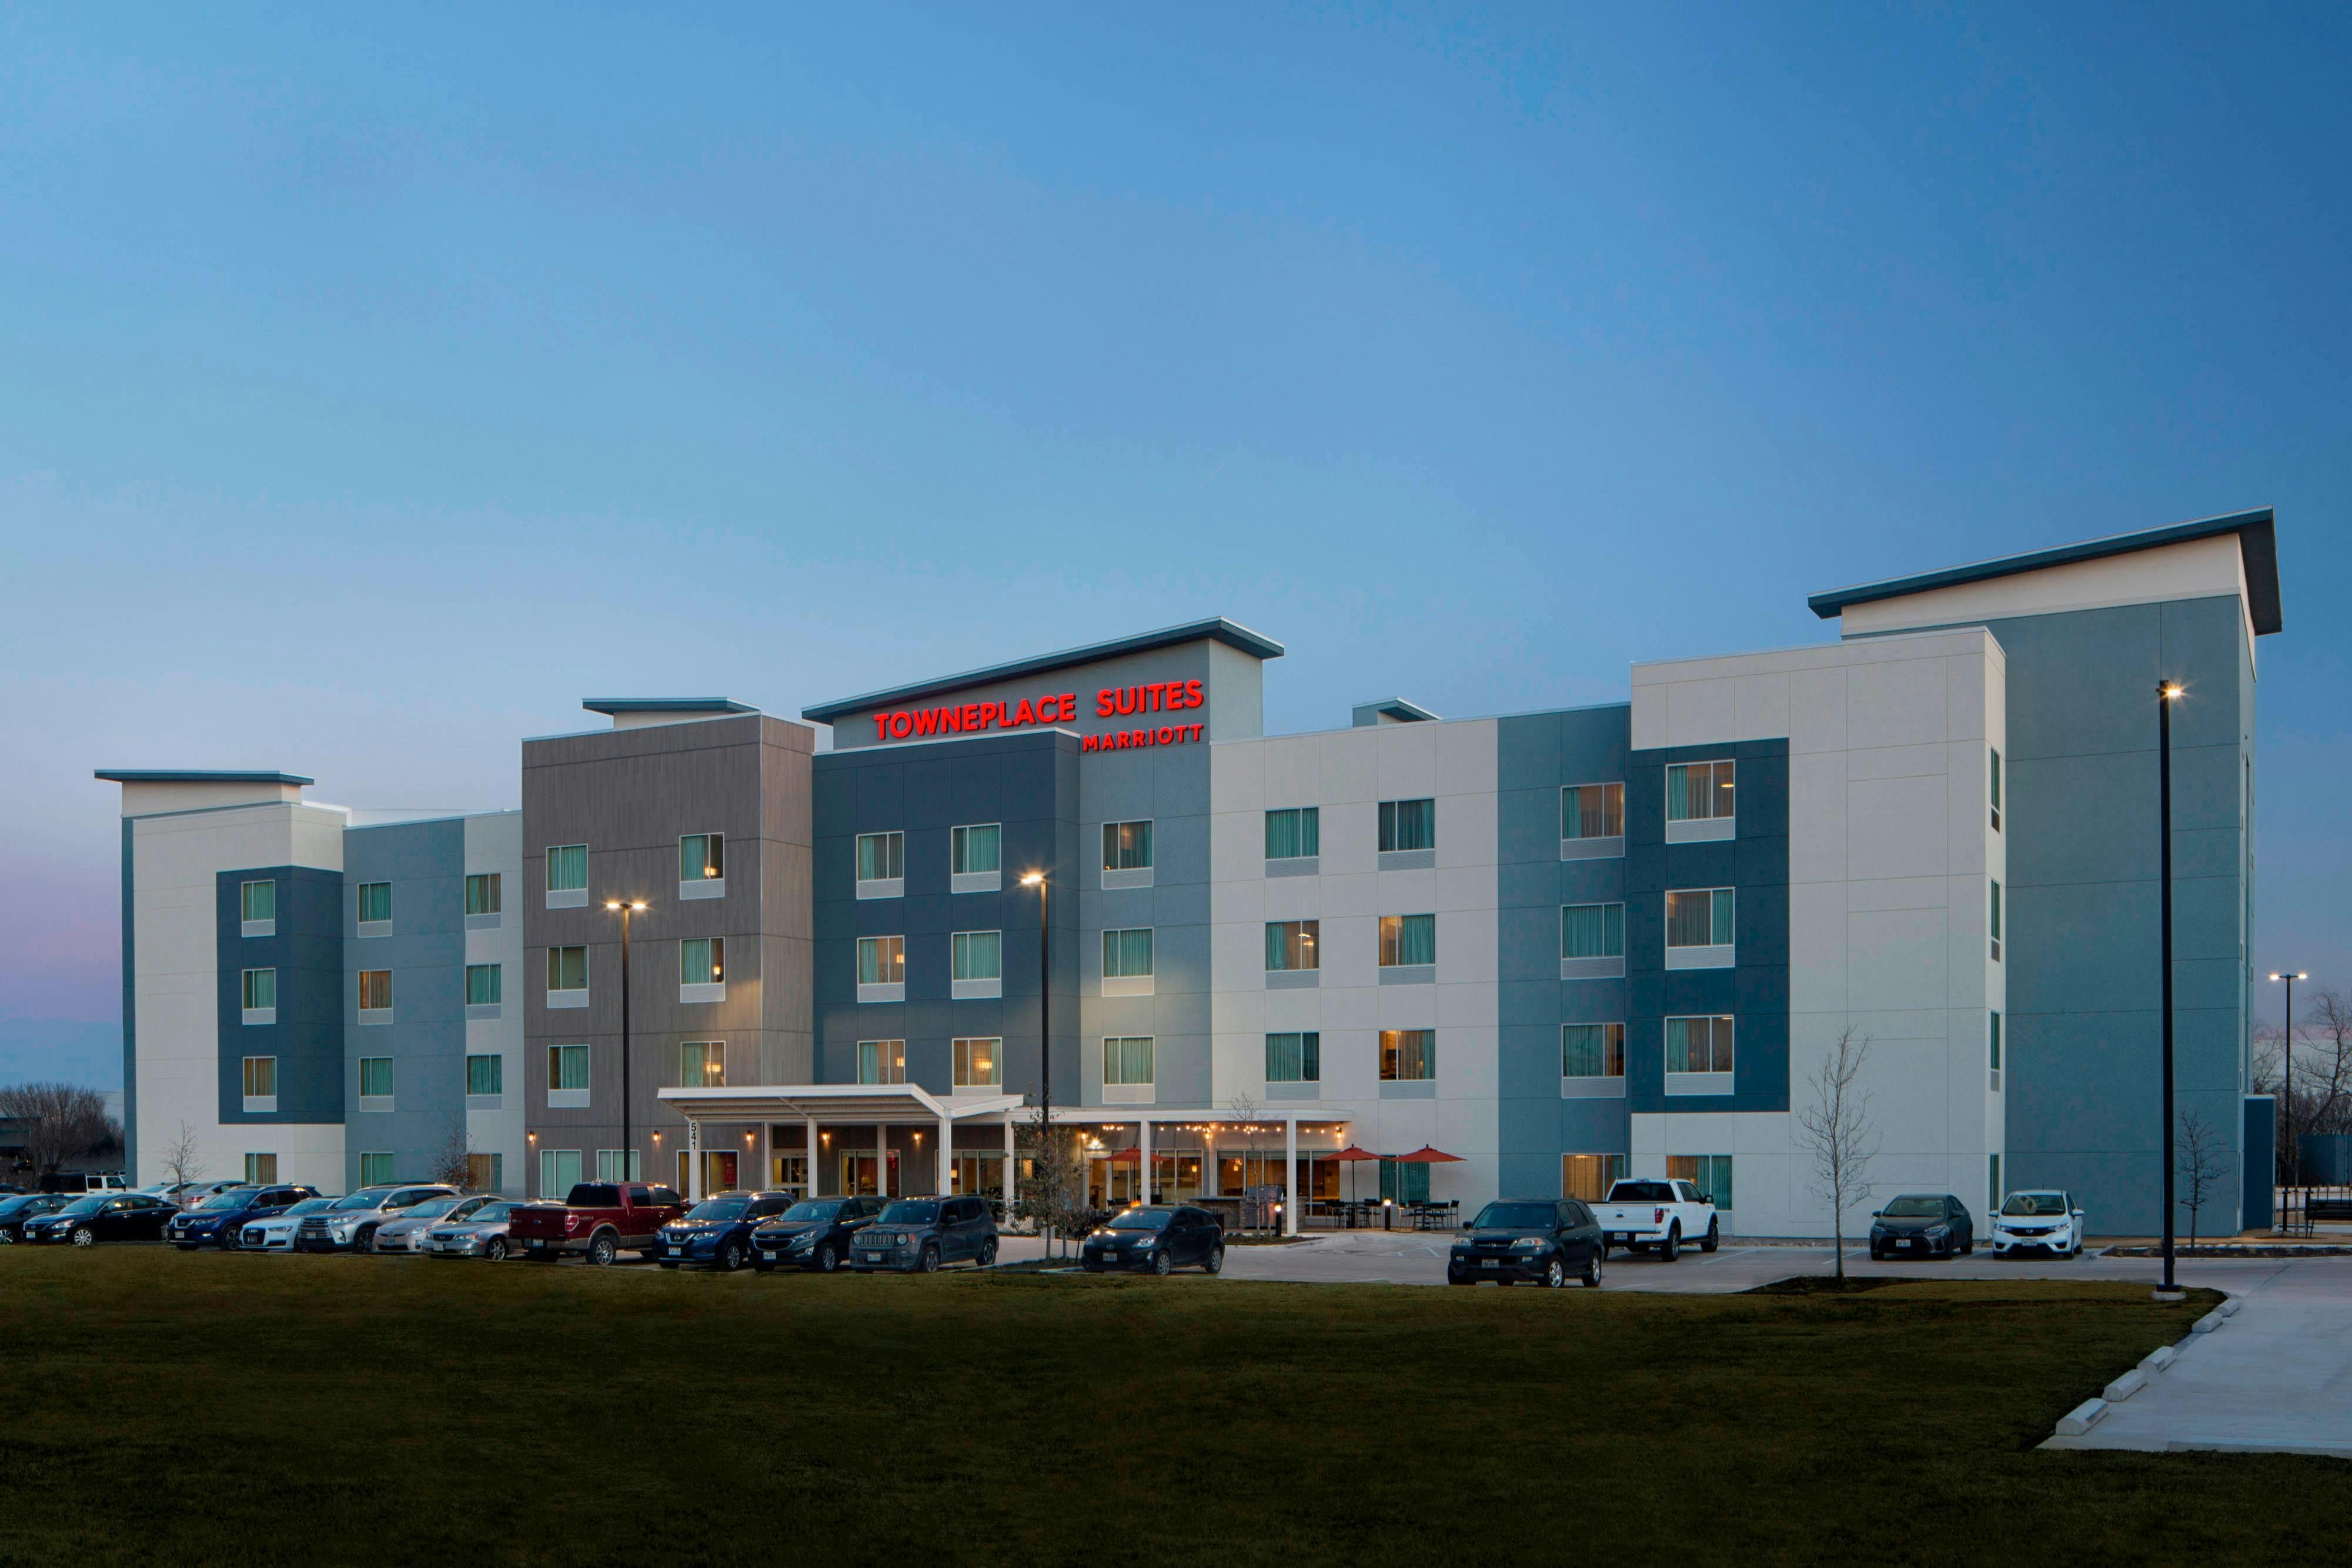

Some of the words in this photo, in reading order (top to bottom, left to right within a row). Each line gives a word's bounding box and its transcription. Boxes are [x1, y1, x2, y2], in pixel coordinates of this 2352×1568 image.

[873, 693, 1075, 739] TOWNEPLACE
[1096, 679, 1203, 717] SUITES
[1083, 724, 1203, 752] MARRIOTT
